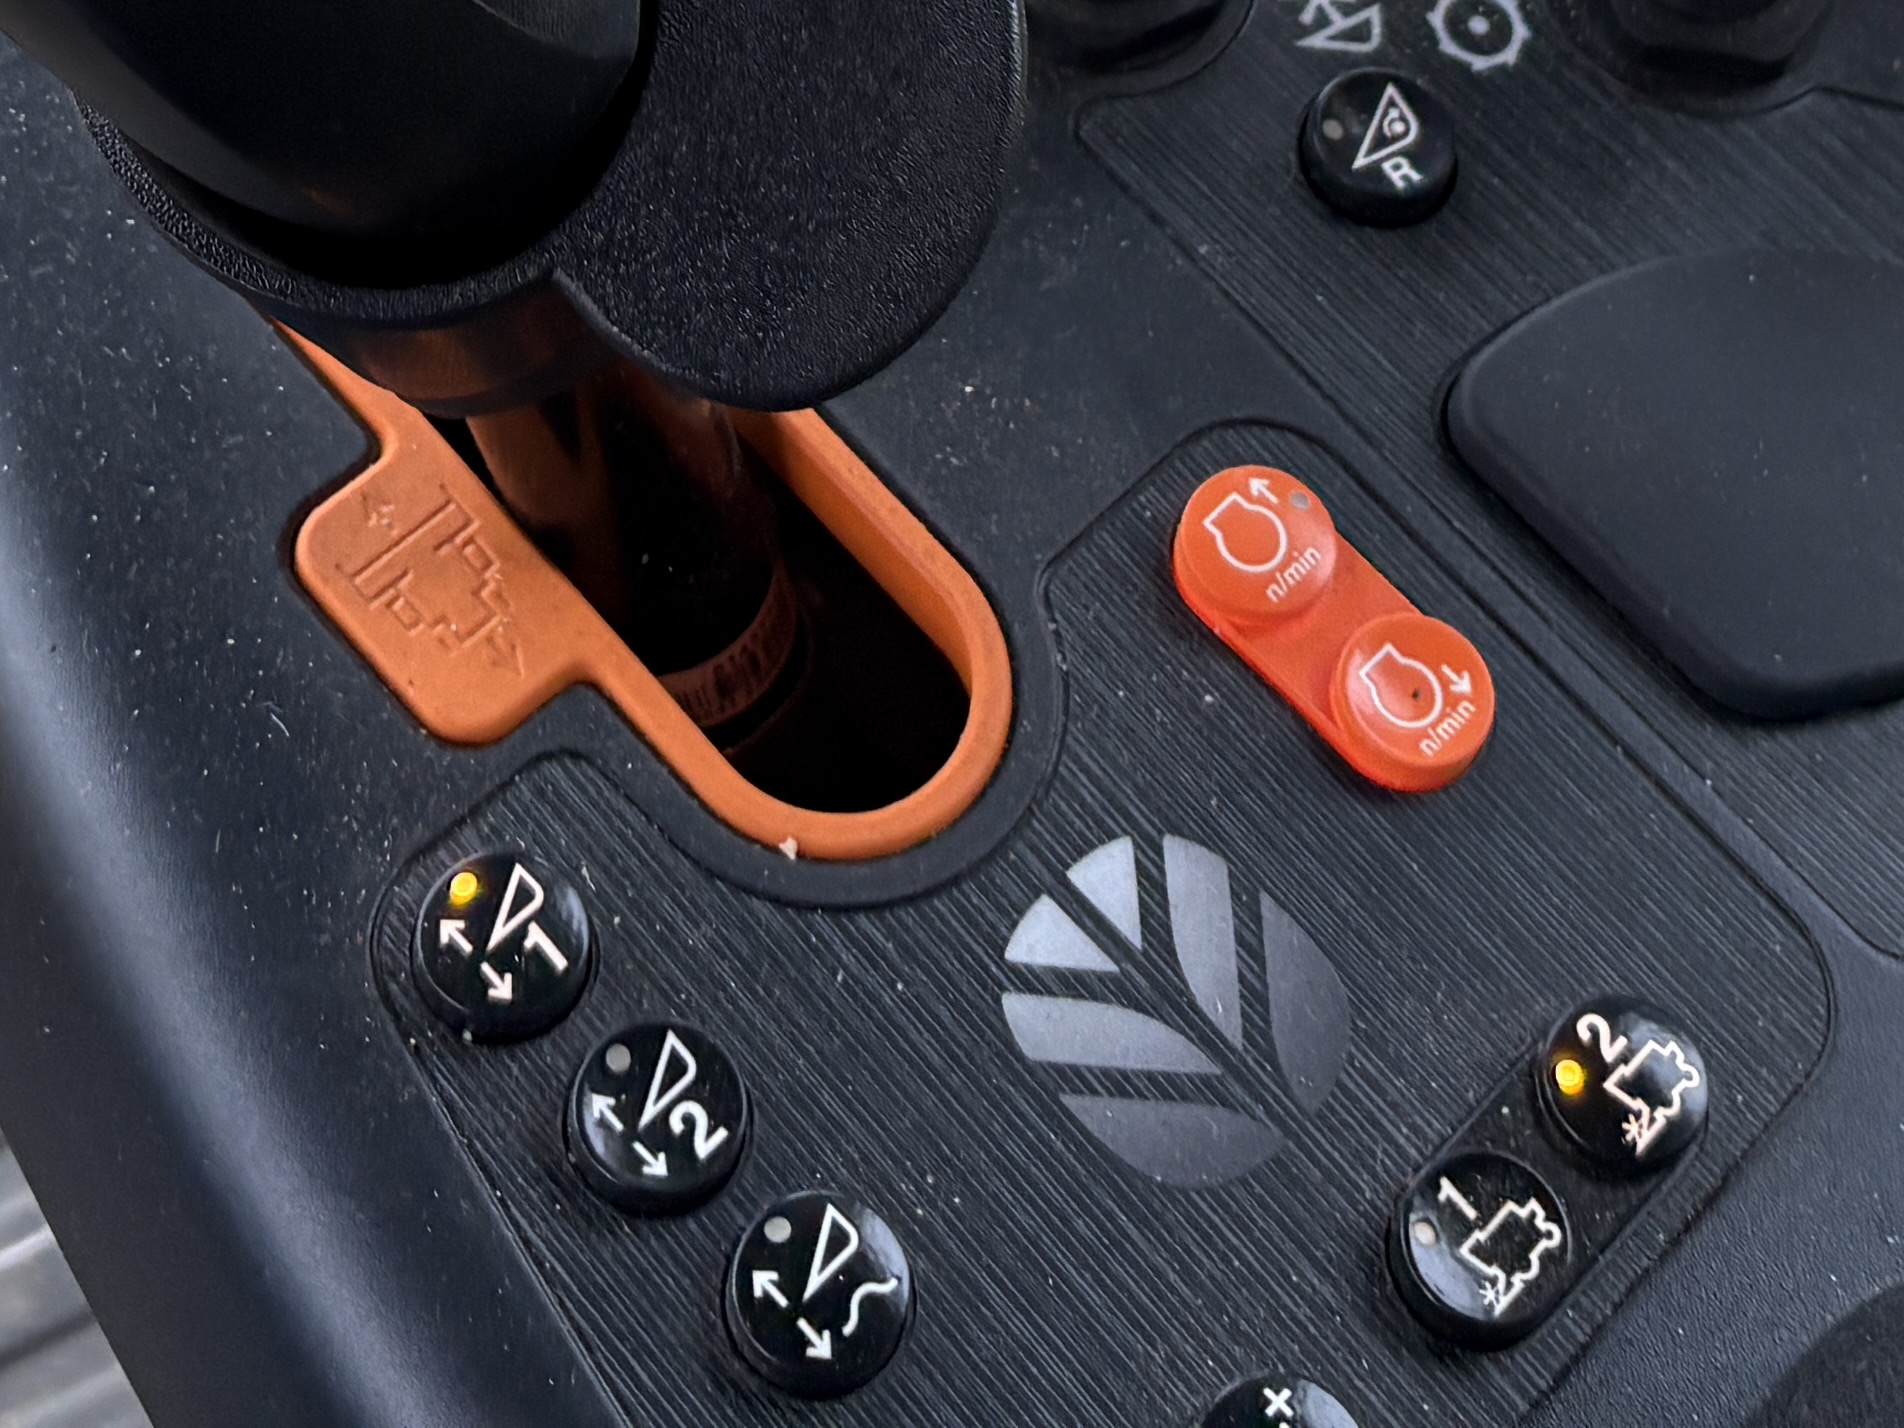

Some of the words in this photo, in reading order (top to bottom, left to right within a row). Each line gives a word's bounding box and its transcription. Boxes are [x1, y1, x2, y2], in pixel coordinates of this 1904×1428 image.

[1380, 155, 1424, 190] R
[1264, 544, 1323, 604] n/min
[1418, 698, 1477, 757] n/min
[524, 921, 569, 972] 1
[1575, 1012, 1629, 1064] 2
[669, 1099, 729, 1161] 2
[1437, 1176, 1479, 1221] 1
